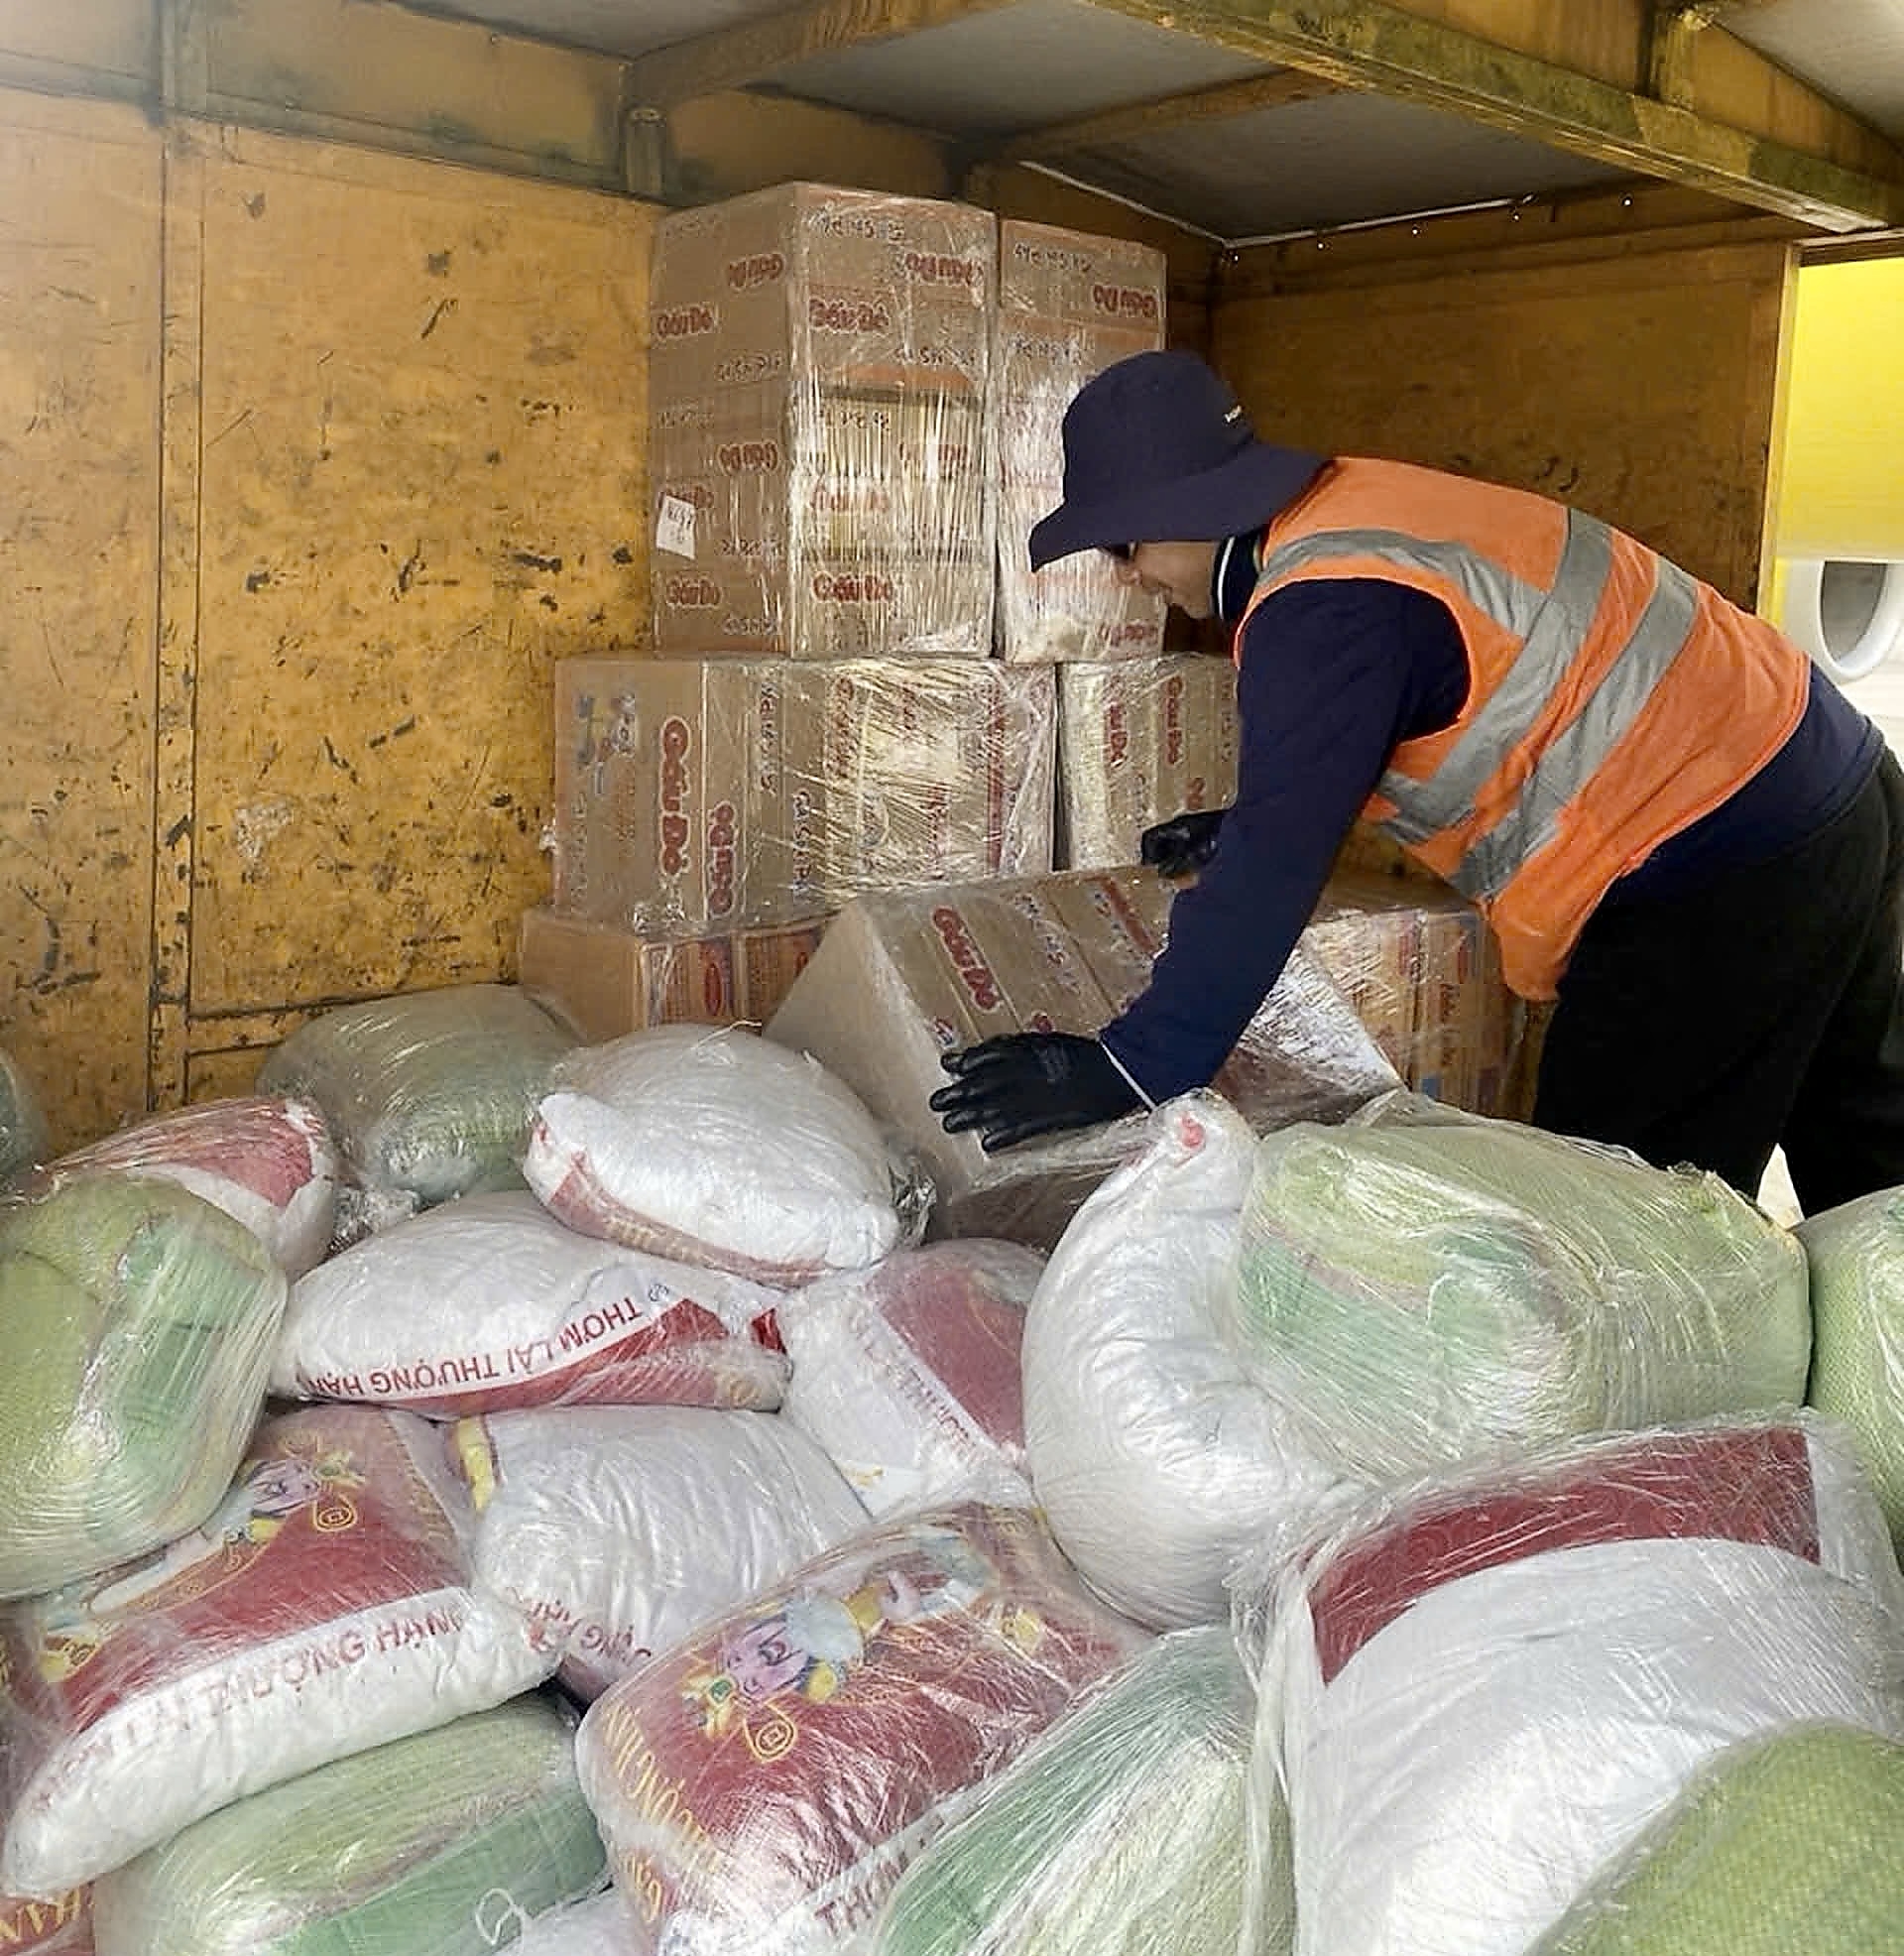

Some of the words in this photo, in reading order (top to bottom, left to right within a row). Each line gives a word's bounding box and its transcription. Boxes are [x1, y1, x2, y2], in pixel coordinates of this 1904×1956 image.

[558, 1296, 644, 1352] THƠM
[370, 1353, 500, 1394] THƯỢNG
[508, 1339, 554, 1375] LÀI
